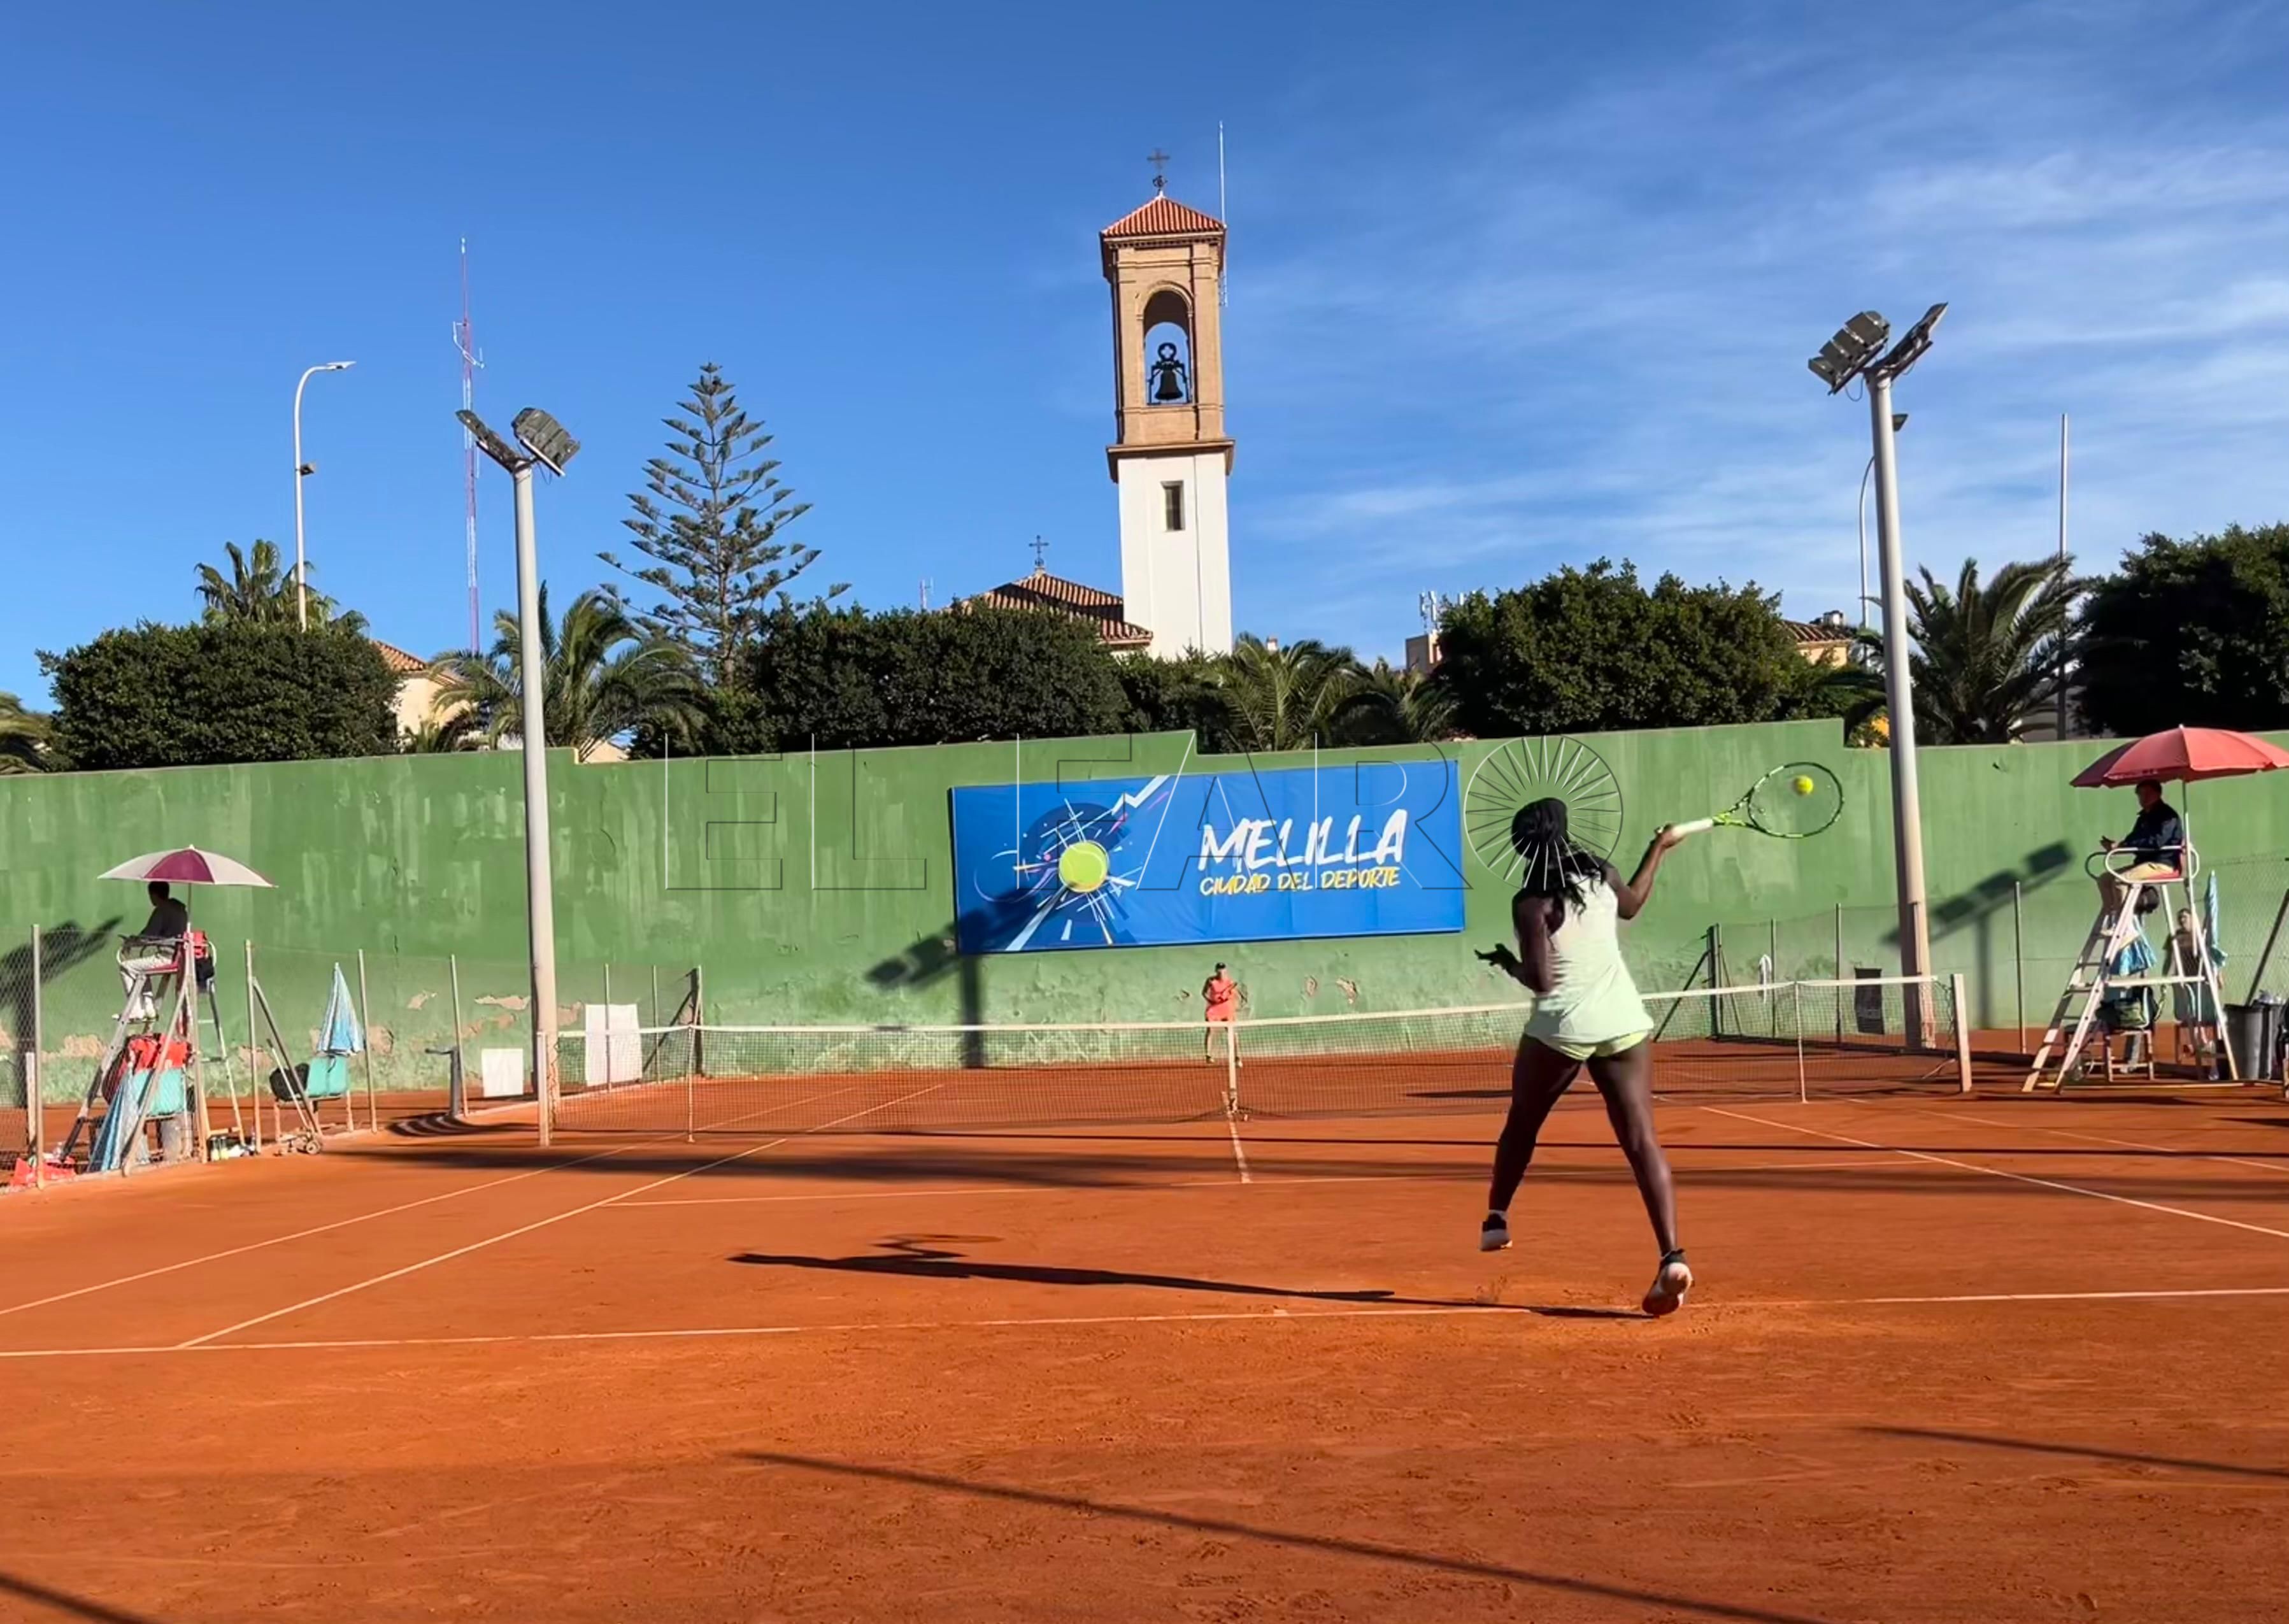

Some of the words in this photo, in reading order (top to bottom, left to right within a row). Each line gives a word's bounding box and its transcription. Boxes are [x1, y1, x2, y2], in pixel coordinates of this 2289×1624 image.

[1198, 808, 1408, 873] MELILLA
[1199, 873, 1271, 896] CIUDAD
[1278, 871, 1312, 892] DEL
[1320, 865, 1401, 889] DEPORTE
